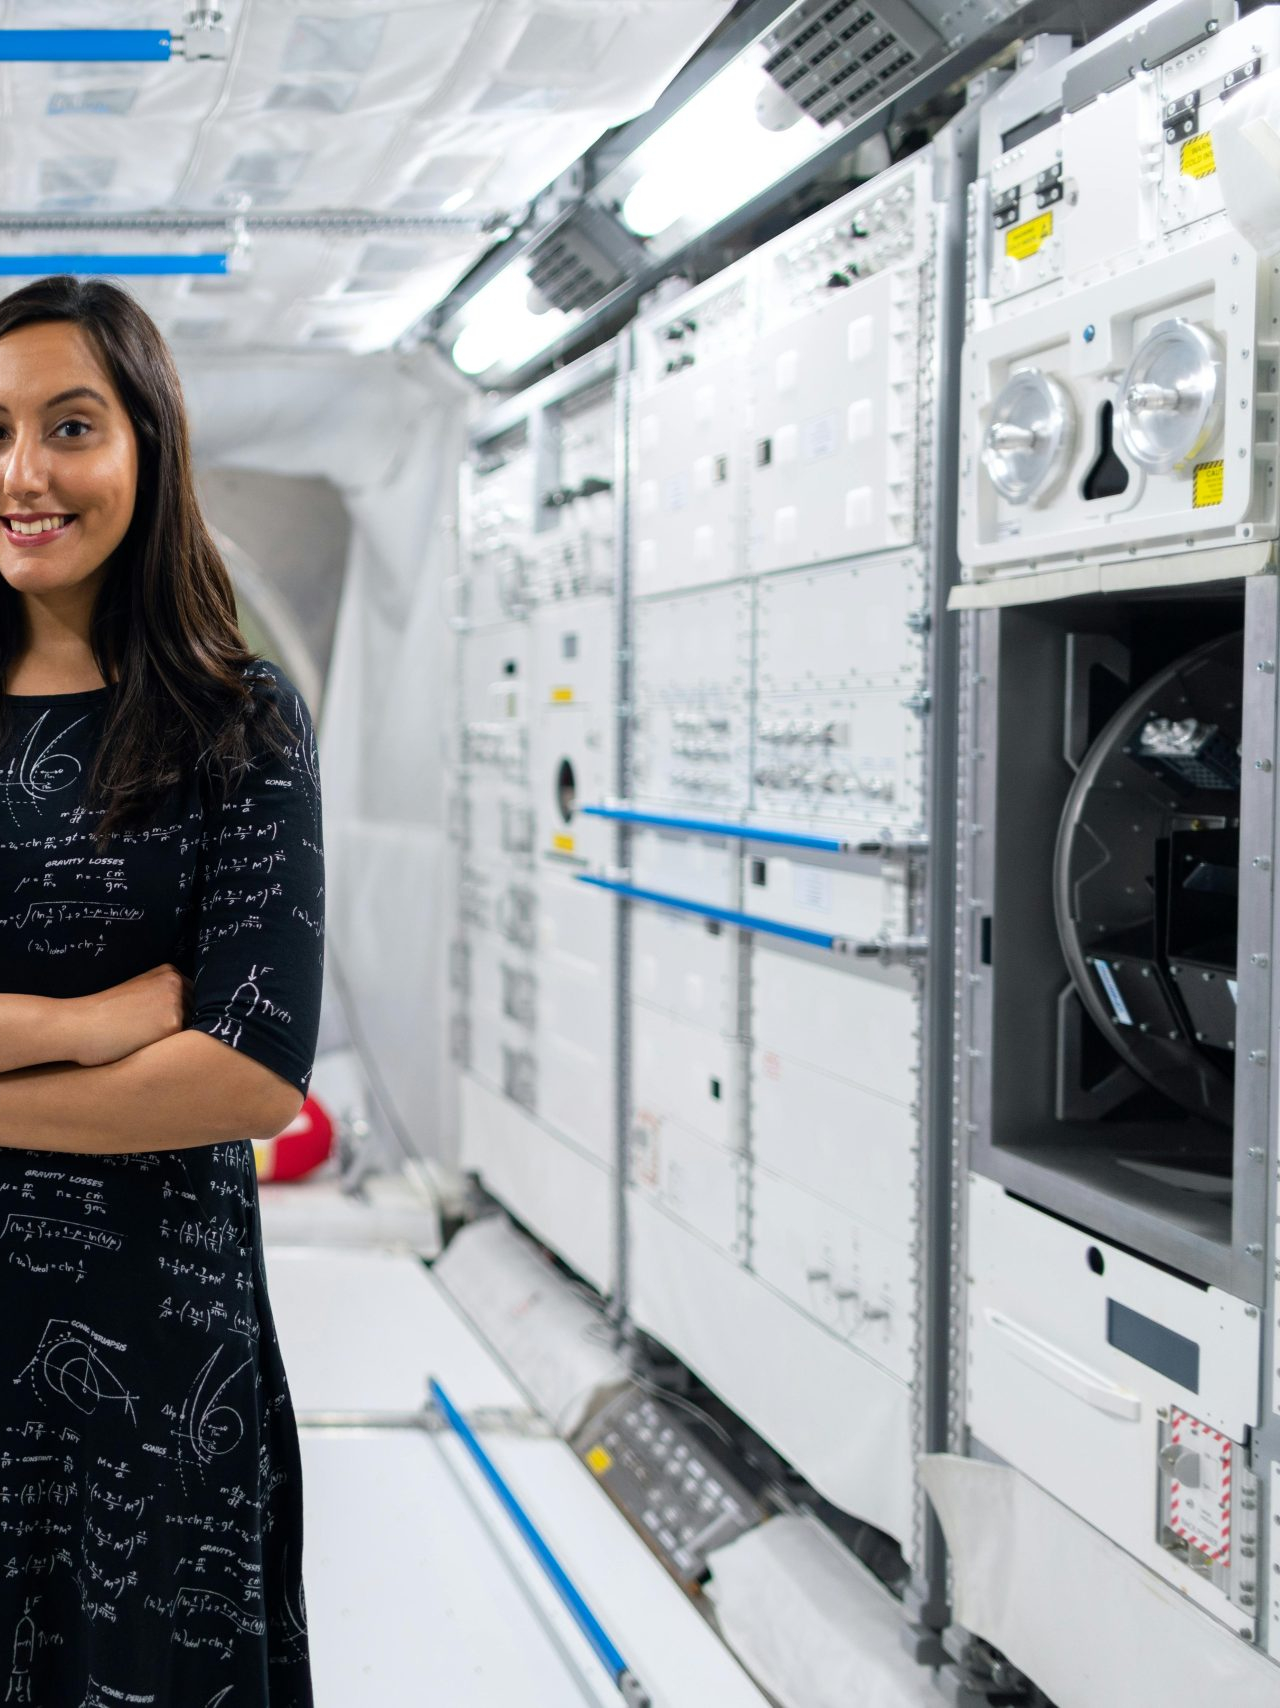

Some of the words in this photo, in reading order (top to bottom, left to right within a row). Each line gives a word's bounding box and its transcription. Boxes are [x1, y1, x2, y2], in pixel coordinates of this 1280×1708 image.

[45, 857, 85, 868] GRAVITY
[89, 857, 125, 866] LOSSES
[24, 1169, 66, 1181] GRAVITY
[69, 1175, 105, 1188] LOSSES
[200, 1544, 236, 1557] GRAVITY
